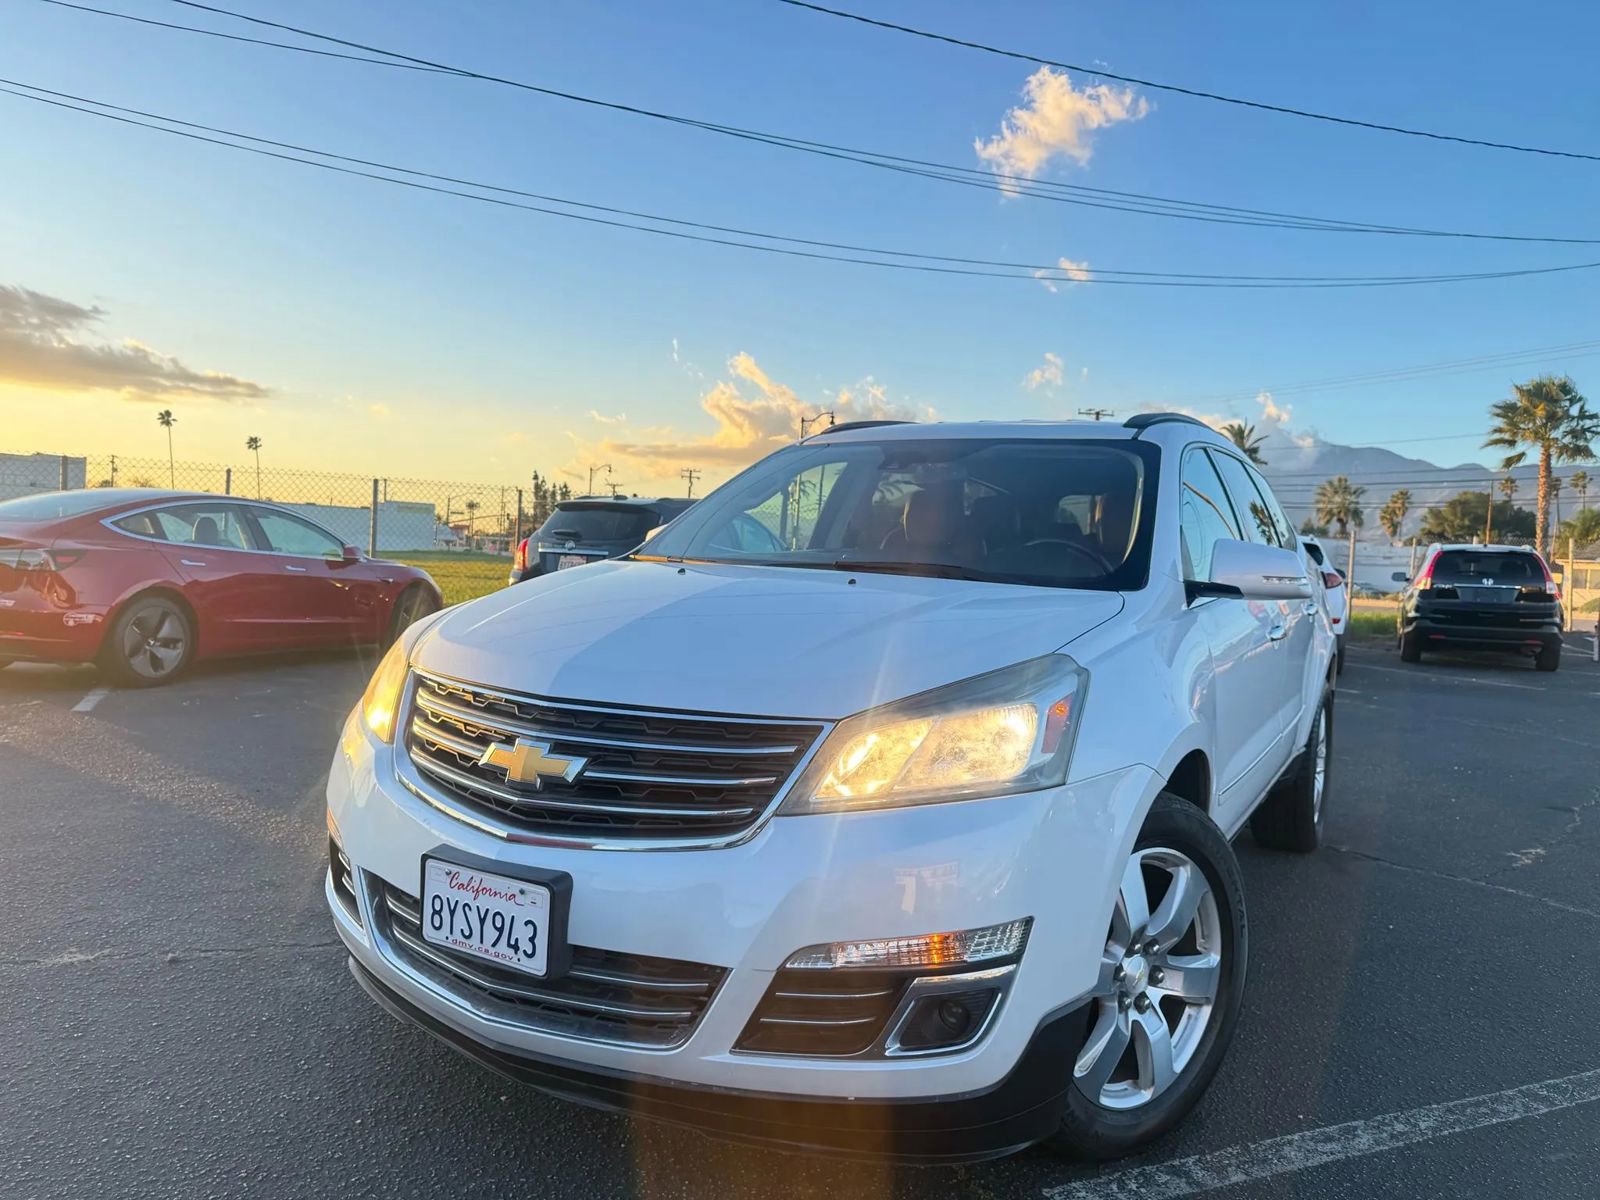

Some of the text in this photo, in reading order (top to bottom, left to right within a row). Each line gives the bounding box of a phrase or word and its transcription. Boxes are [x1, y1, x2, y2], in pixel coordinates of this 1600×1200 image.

[449, 871, 524, 907] California
[430, 894, 538, 959] 8YSY943
[451, 938, 514, 961] dmv.ca.gov
